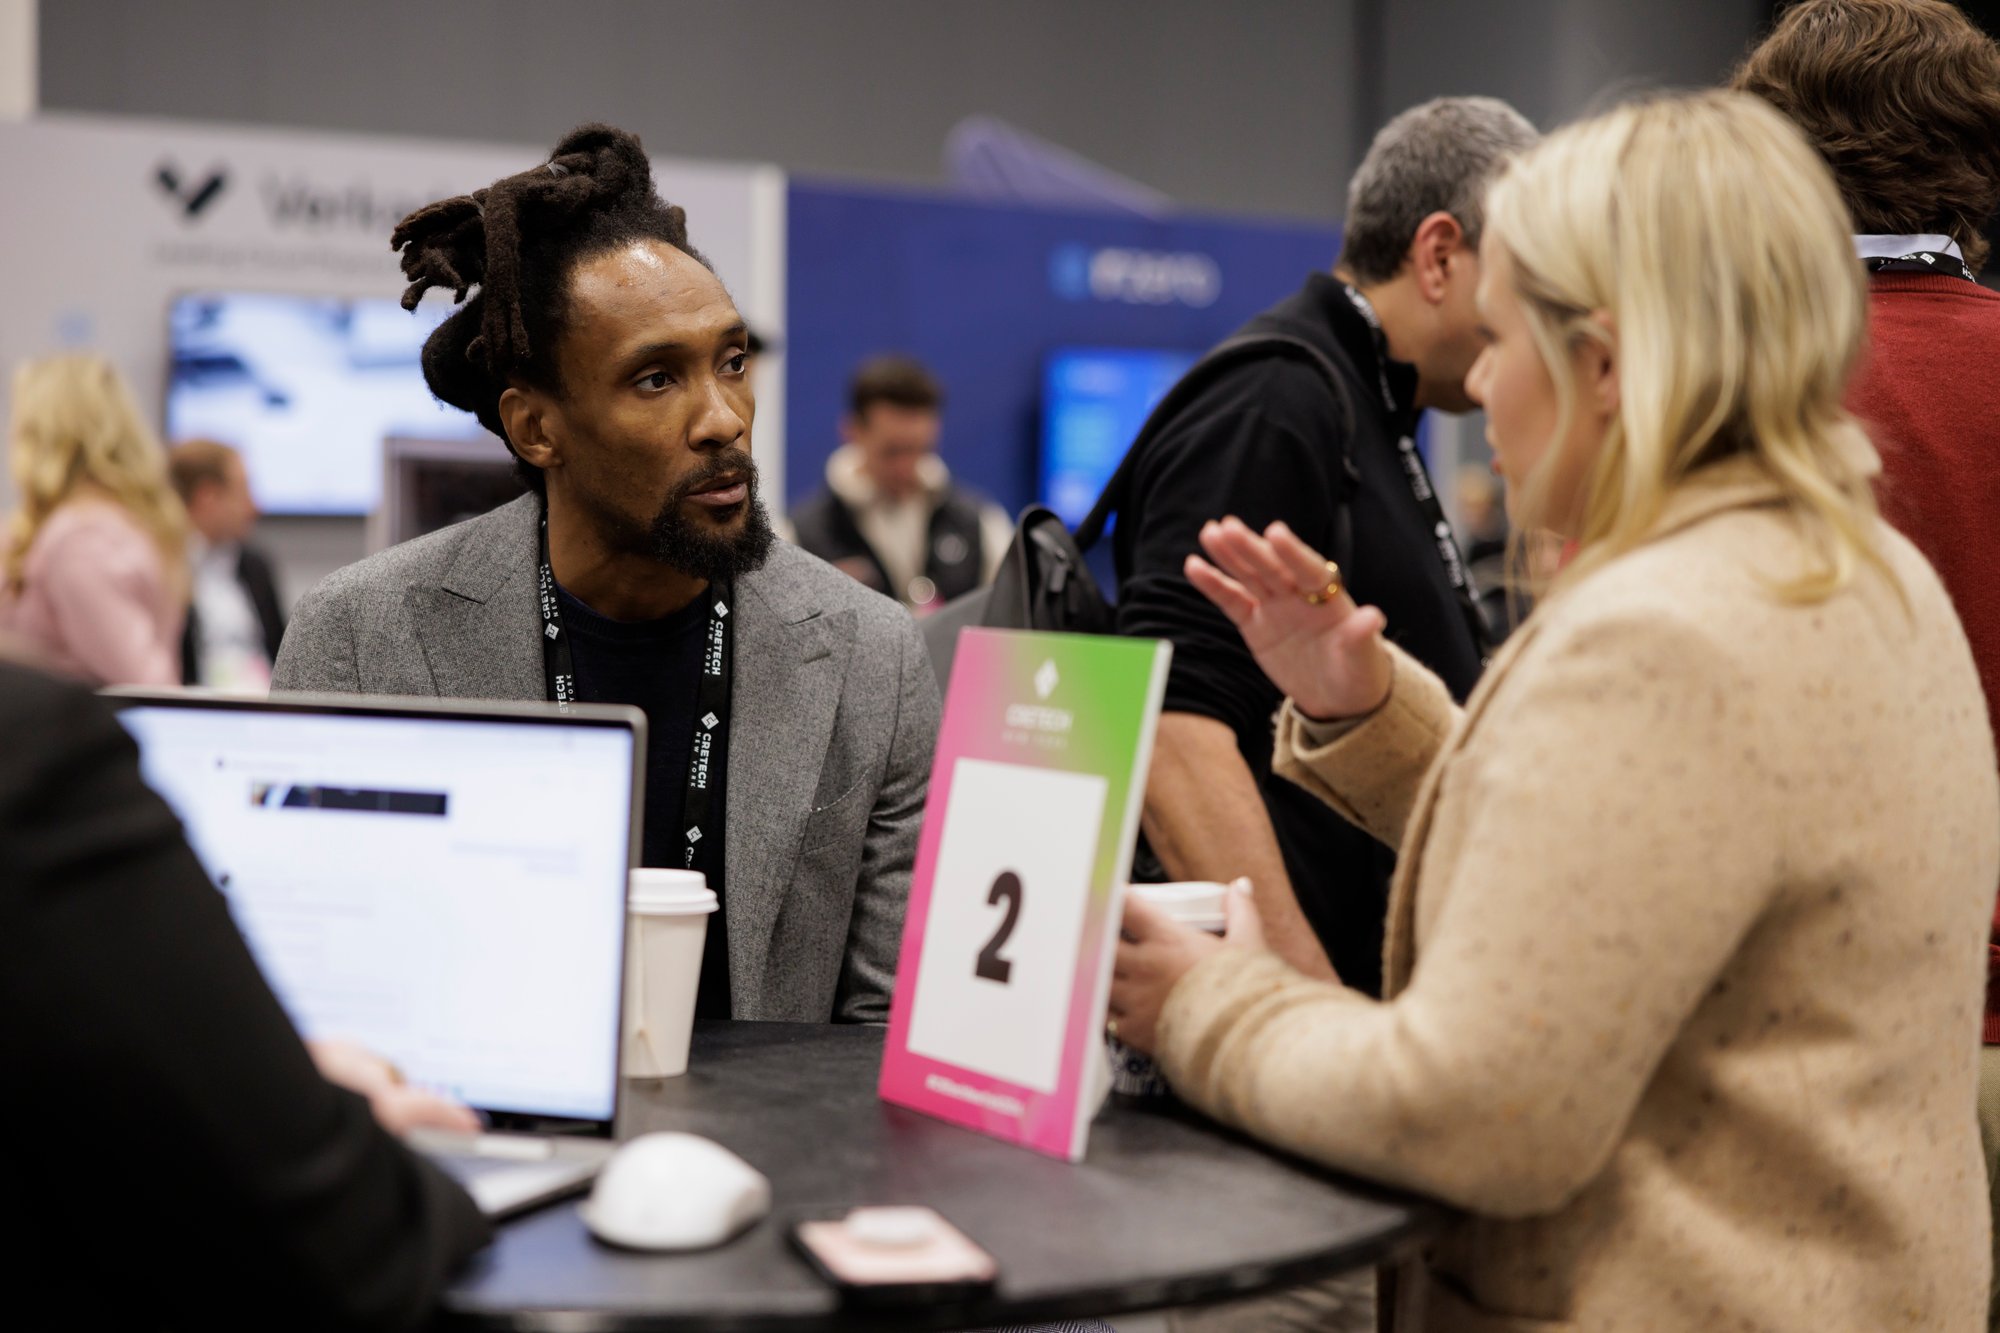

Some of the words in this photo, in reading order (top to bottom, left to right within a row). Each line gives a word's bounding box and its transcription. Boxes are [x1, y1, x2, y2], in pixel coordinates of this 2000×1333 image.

[550, 597, 559, 617] NEW
[704, 647, 712, 674] YORK
[711, 621, 724, 676] CRETECH
[555, 675, 569, 714] ETECH
[566, 674, 575, 702] YORK
[693, 731, 702, 753] NEW
[690, 760, 698, 787] YORK
[697, 732, 712, 789] CRETECH
[975, 871, 1022, 984] 2
